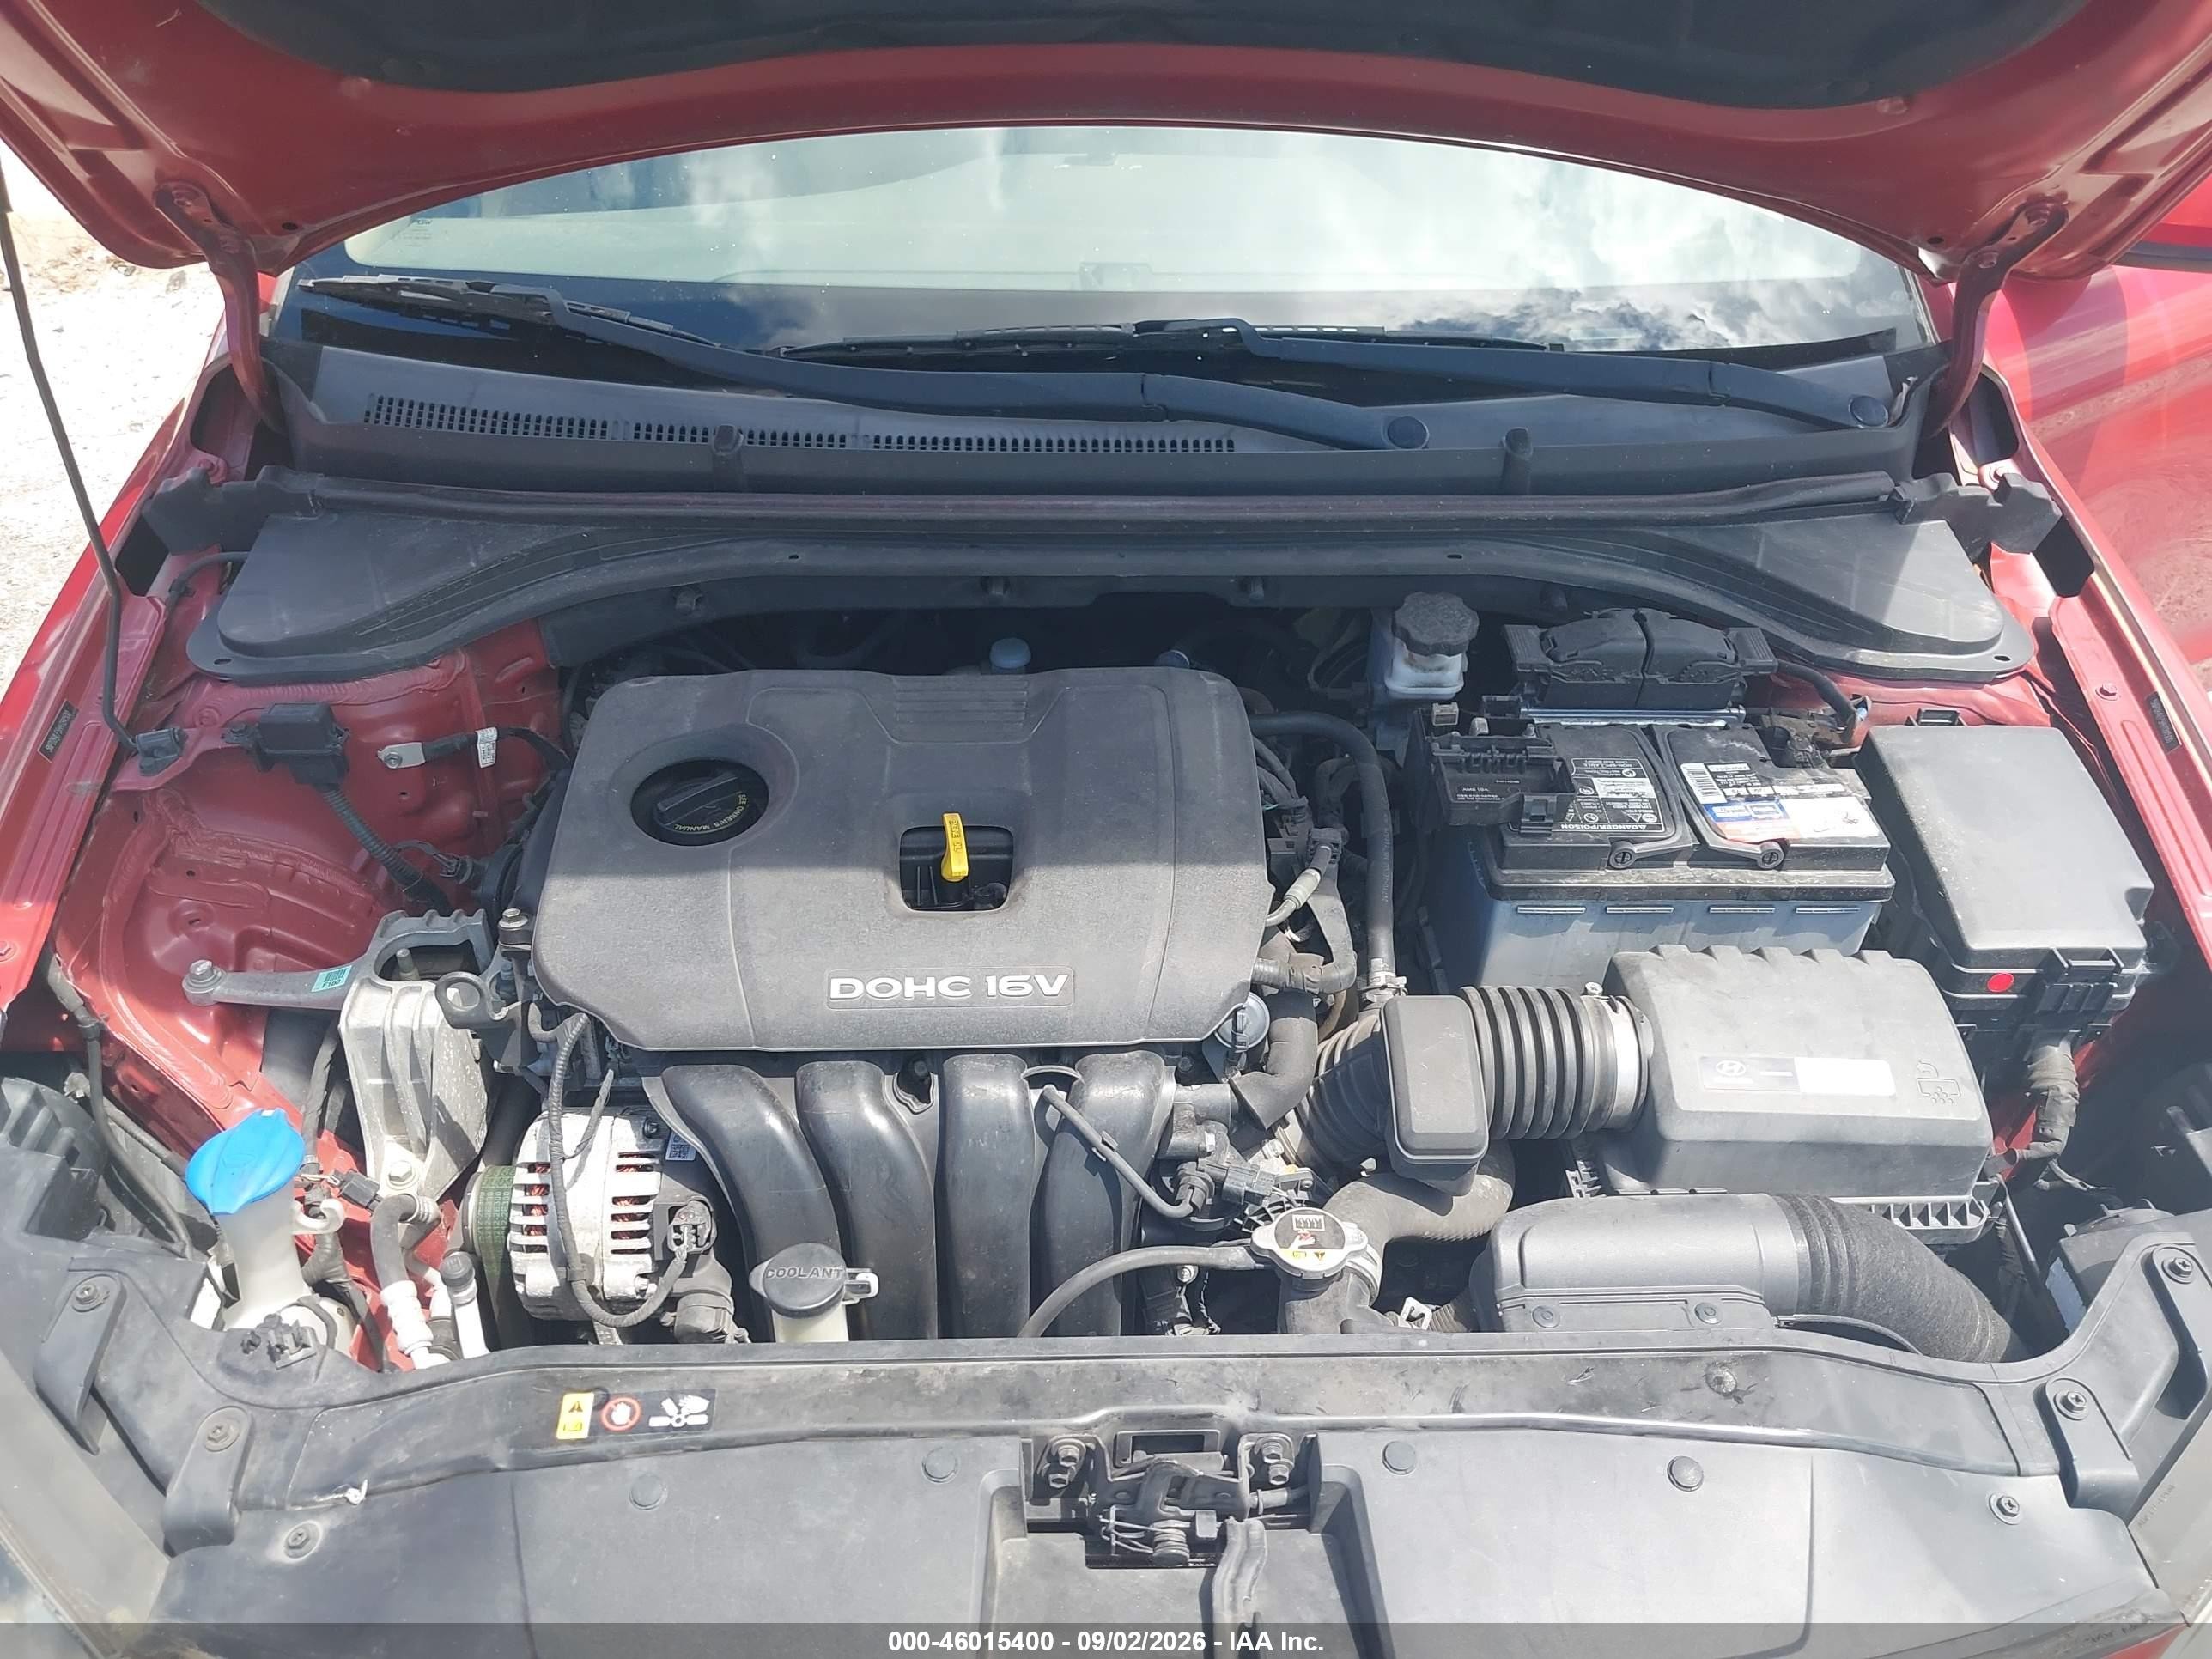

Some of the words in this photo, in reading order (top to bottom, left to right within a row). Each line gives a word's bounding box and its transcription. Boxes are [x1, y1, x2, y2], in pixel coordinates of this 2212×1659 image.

[738, 793, 747, 805] SEE
[714, 805, 744, 827] OWNER'S
[673, 823, 710, 833] MANUAL
[830, 975, 972, 1000] DOHC
[986, 975, 1069, 998] 16V
[765, 1266, 843, 1279] COOLANT
